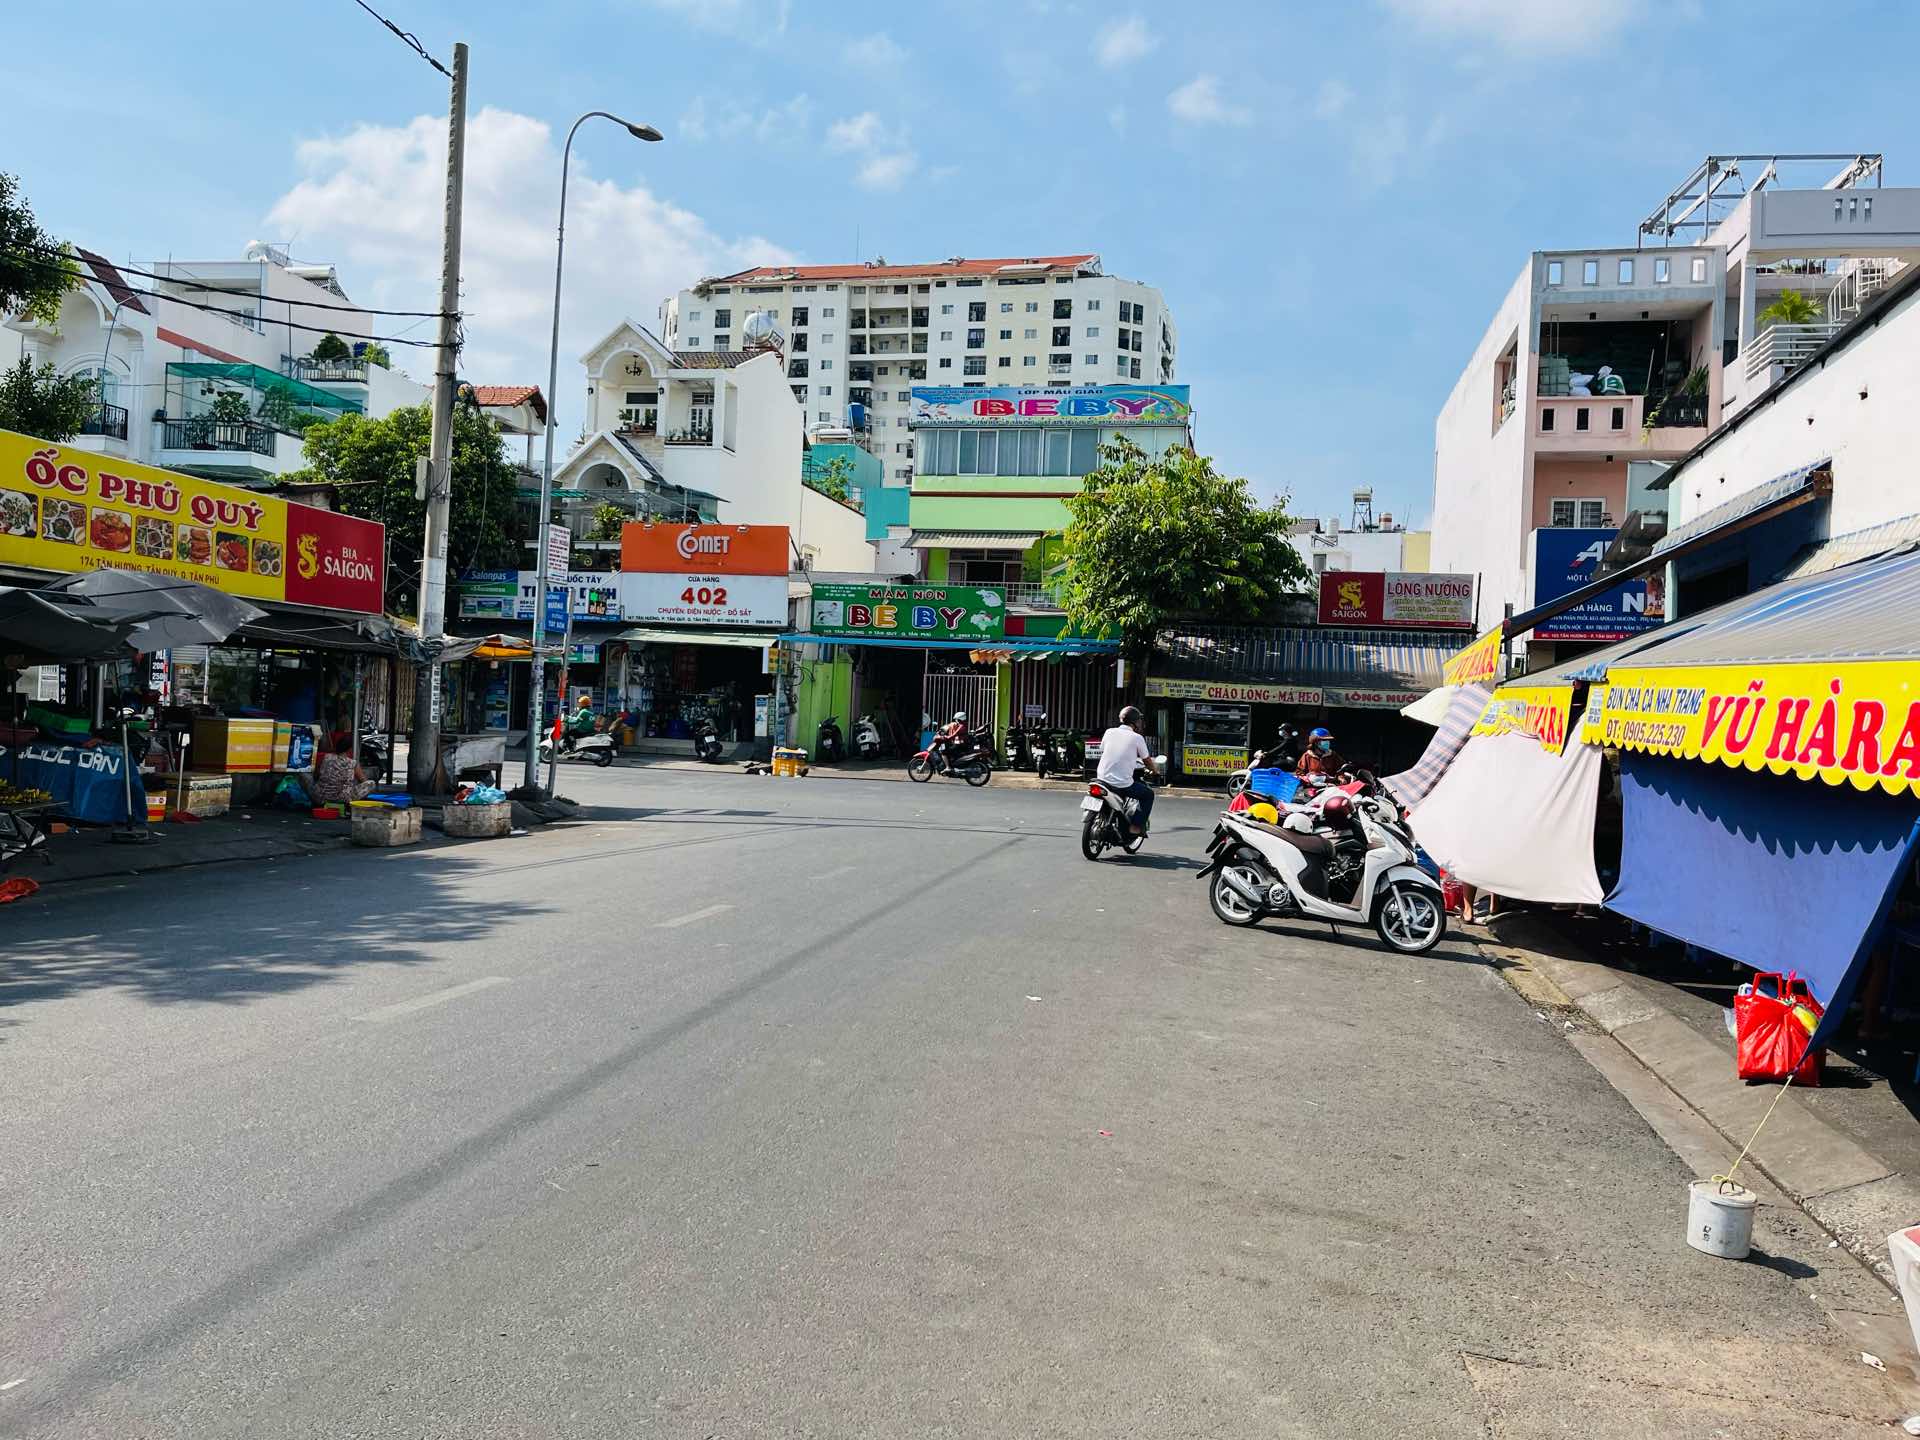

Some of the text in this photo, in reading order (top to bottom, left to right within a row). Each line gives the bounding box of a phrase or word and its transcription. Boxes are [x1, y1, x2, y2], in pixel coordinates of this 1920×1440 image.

[25, 448, 88, 494] ỐC
[342, 547, 357, 560] BIA
[324, 556, 373, 582] SAIGON
[681, 587, 728, 605] 402
[912, 589, 947, 601] NON
[912, 605, 966, 630] BY
[1331, 609, 1367, 618] SAIGON
[1586, 602, 1613, 612] HÀNG
[1297, 692, 1320, 703] HEO
[1673, 688, 1706, 715] TRANG
[1701, 680, 1766, 753] VŨ
[1606, 719, 1687, 747] ĐT: 0905.225.230
